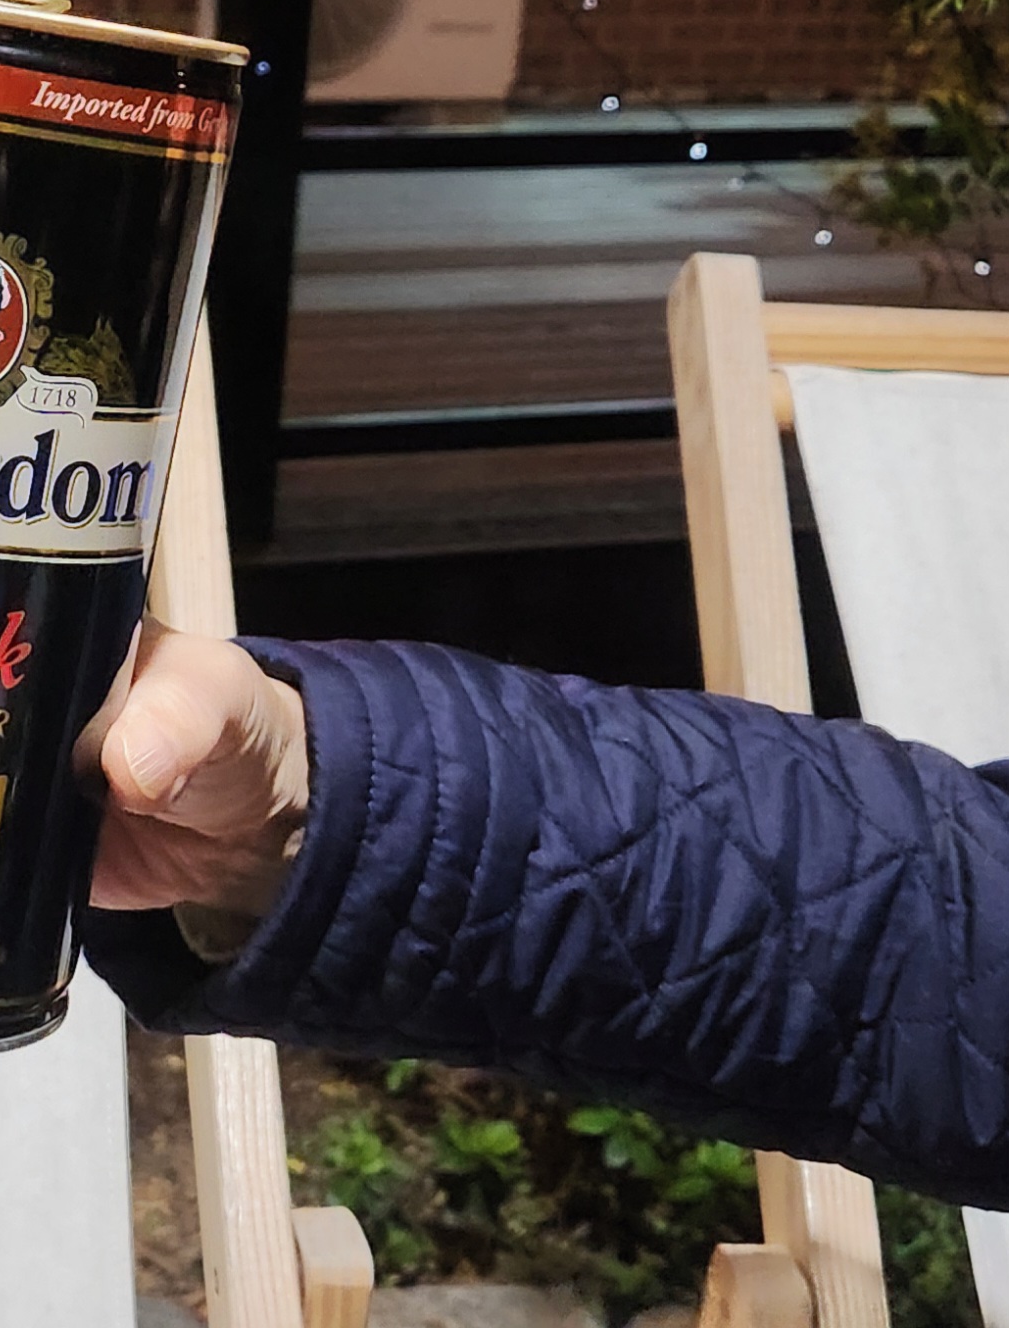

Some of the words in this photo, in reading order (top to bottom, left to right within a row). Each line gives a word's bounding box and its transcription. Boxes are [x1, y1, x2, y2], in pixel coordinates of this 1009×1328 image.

[31, 80, 151, 124] Imported
[142, 98, 196, 133] from
[30, 386, 77, 407] 1718
